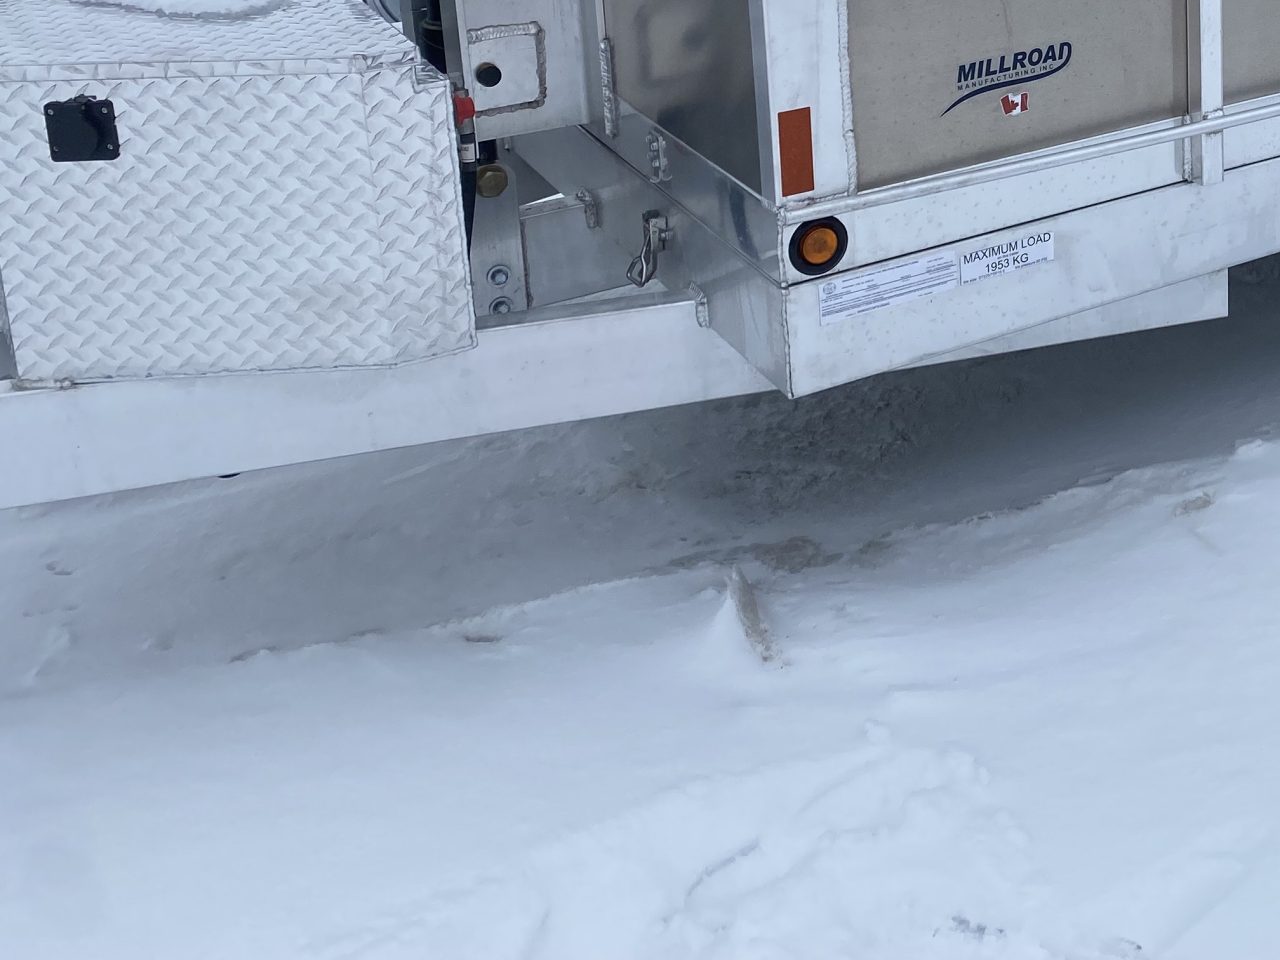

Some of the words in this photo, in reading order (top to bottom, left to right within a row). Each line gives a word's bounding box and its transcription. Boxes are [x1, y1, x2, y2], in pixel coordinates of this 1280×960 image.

[957, 42, 1072, 83] MILLROAD
[957, 68, 1036, 91] MANUFACTURING
[963, 241, 1018, 265] MAXIMUM
[1021, 232, 1051, 249] LOAD
[985, 258, 1010, 273] 1953
[1013, 253, 1029, 266] KG
